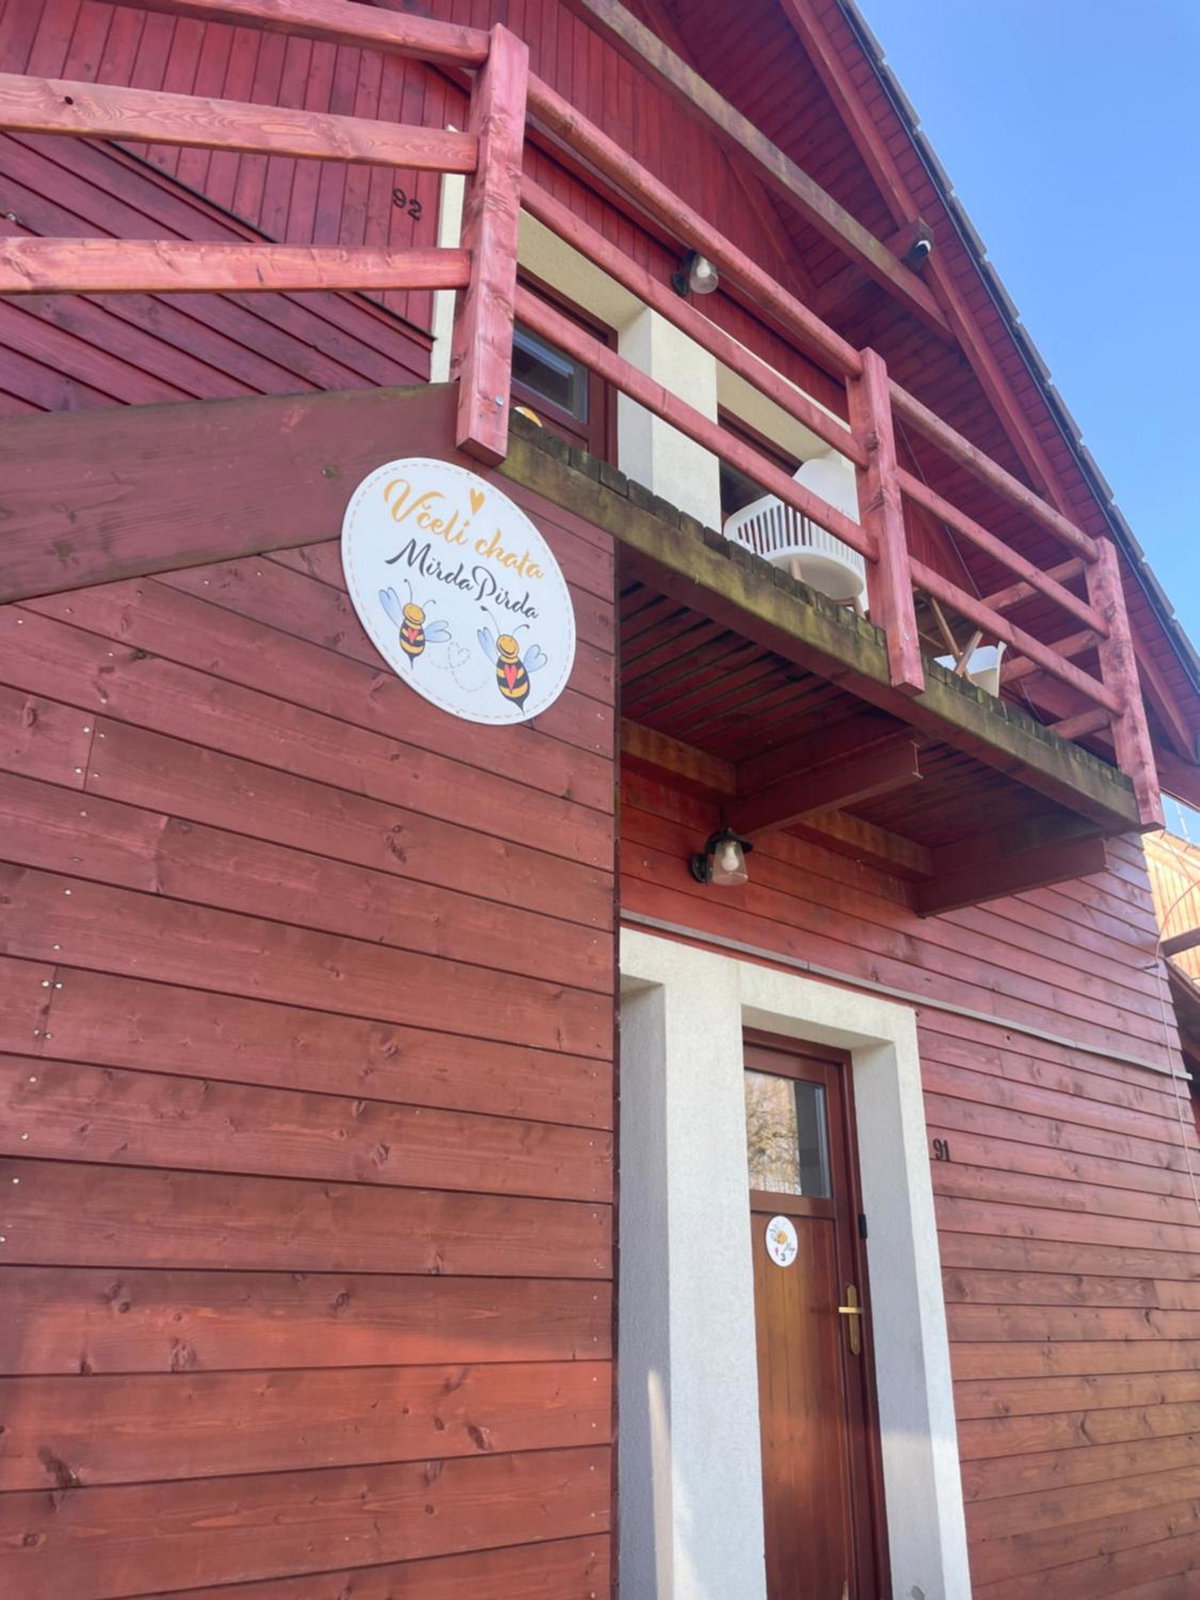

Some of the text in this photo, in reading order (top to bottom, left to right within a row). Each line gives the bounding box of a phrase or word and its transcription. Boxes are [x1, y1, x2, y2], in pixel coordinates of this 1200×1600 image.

[392, 188, 422, 221] 92
[474, 527, 544, 579] chata
[932, 1138, 951, 1163] 91
